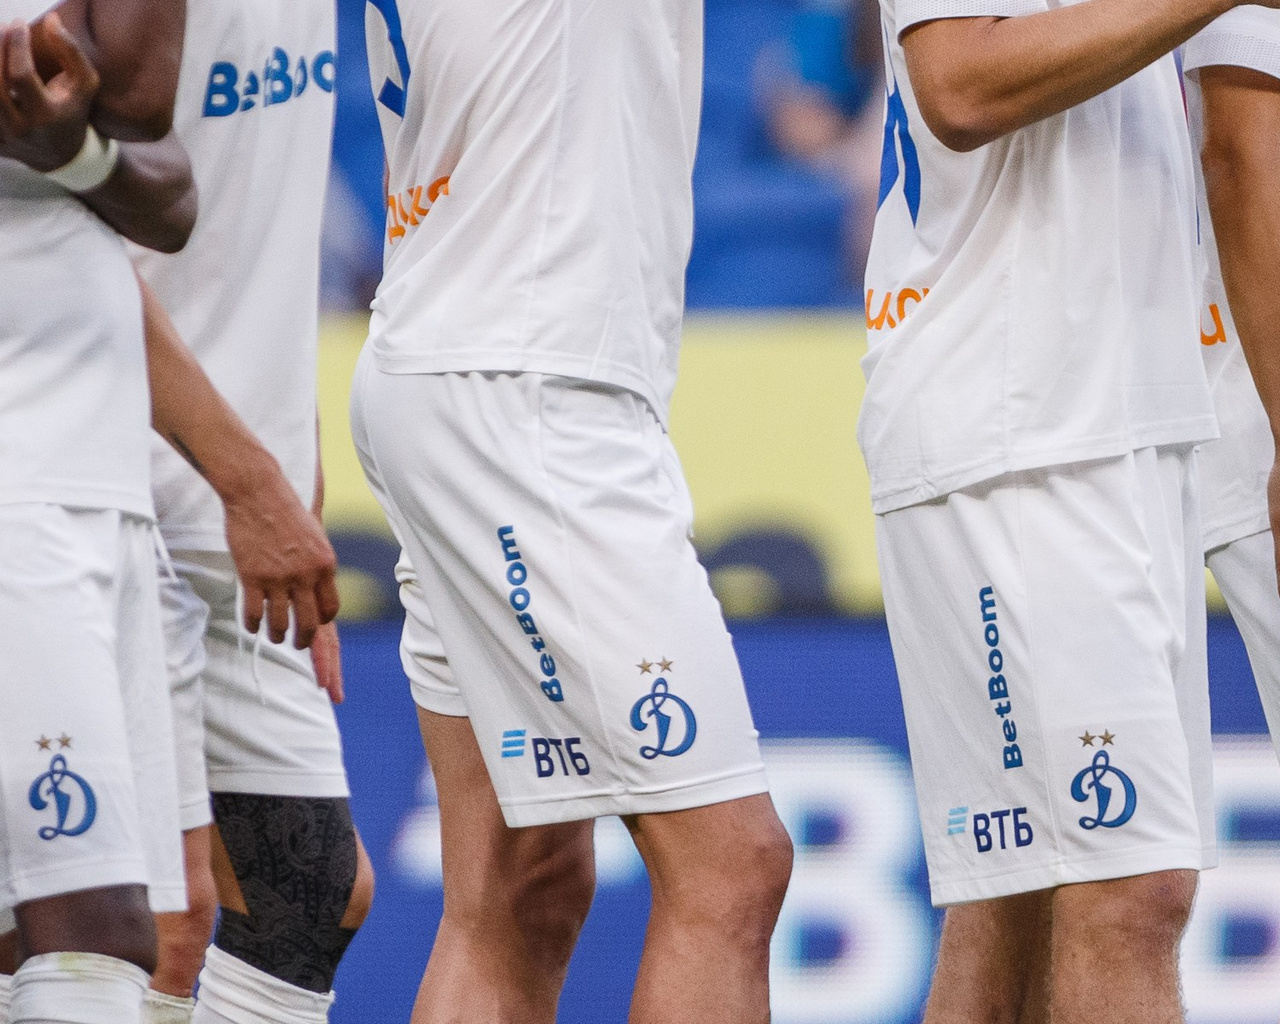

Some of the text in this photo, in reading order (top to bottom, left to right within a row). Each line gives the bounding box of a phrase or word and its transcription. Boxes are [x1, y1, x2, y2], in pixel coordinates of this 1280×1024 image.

[497, 524, 565, 703] BetBoom
[979, 585, 1024, 769] BetBoom
[532, 737, 591, 778] ВТБ
[973, 807, 1034, 853] ВТБ
